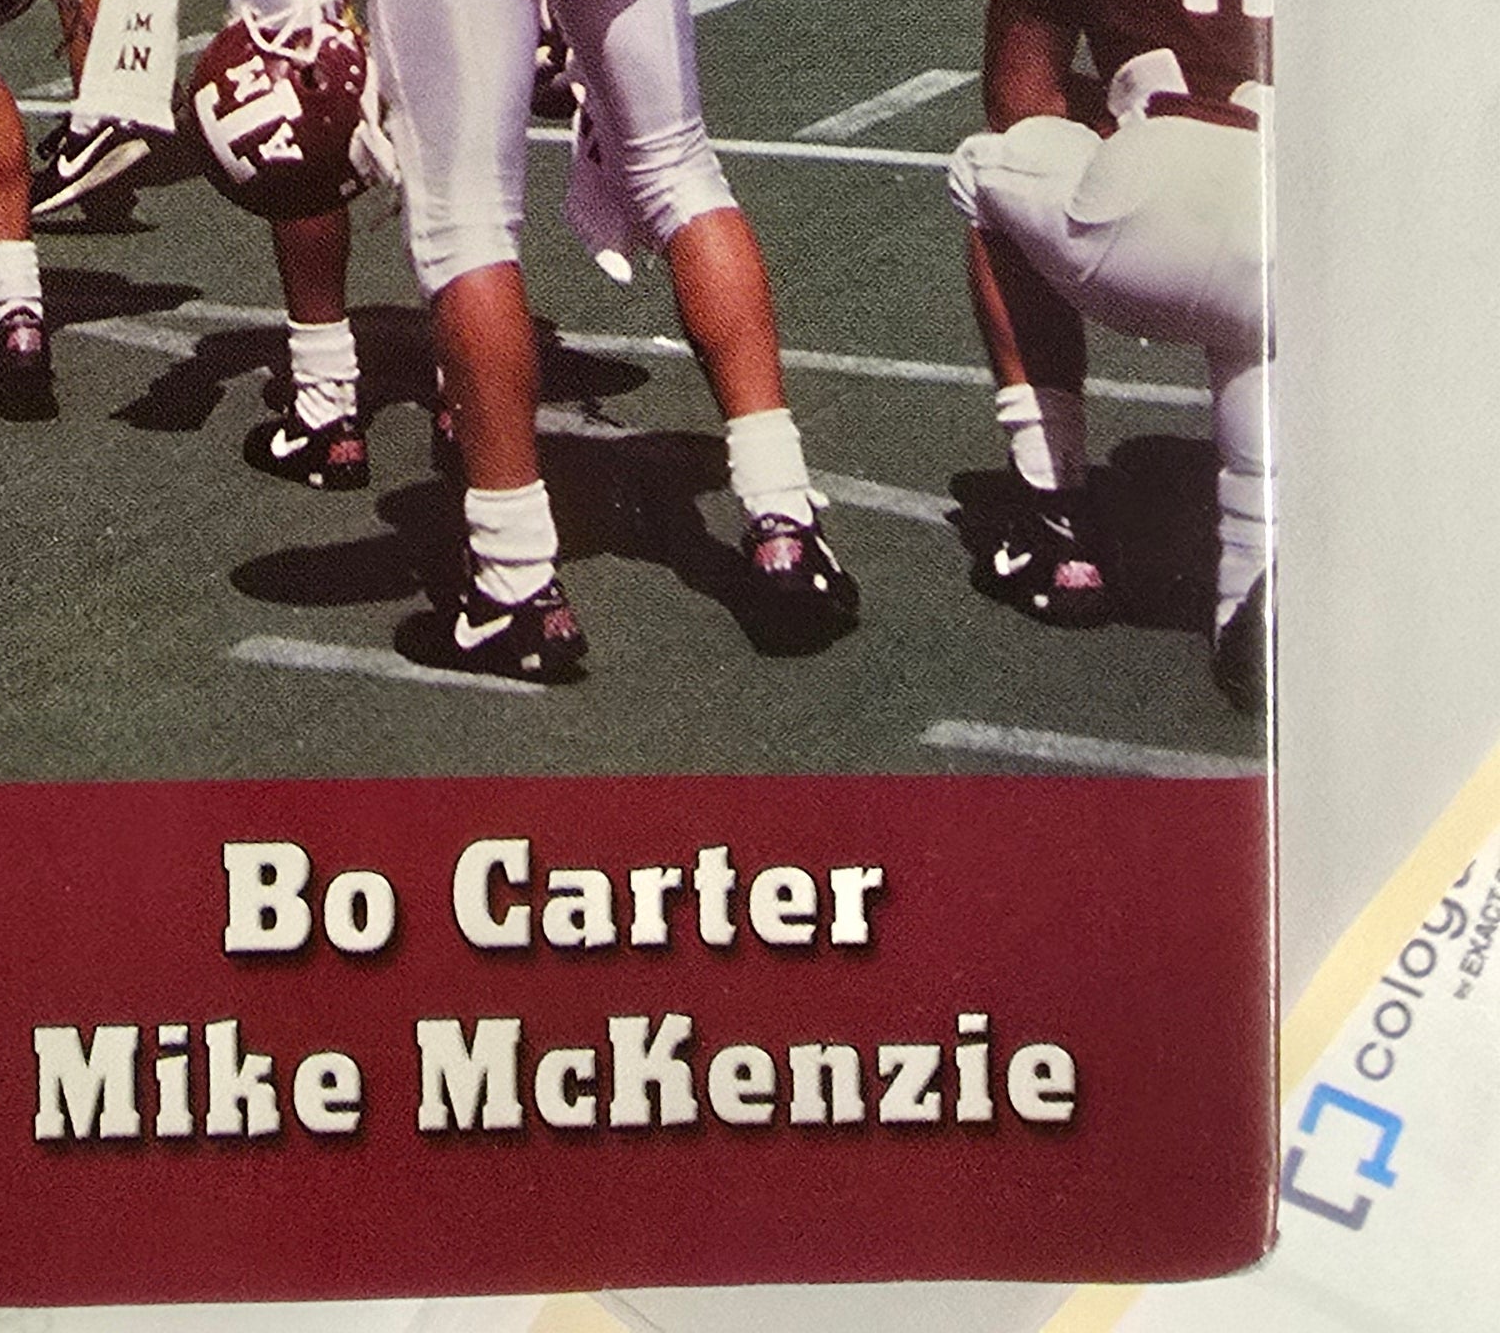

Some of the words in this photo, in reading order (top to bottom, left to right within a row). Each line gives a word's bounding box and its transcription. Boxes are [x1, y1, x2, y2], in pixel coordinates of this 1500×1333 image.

[222, 839, 395, 953] Bo
[450, 837, 885, 948] Carter
[1355, 859, 1477, 1081] colog
[32, 1017, 362, 1140] Mike
[414, 1011, 1078, 1132] McKenzie
